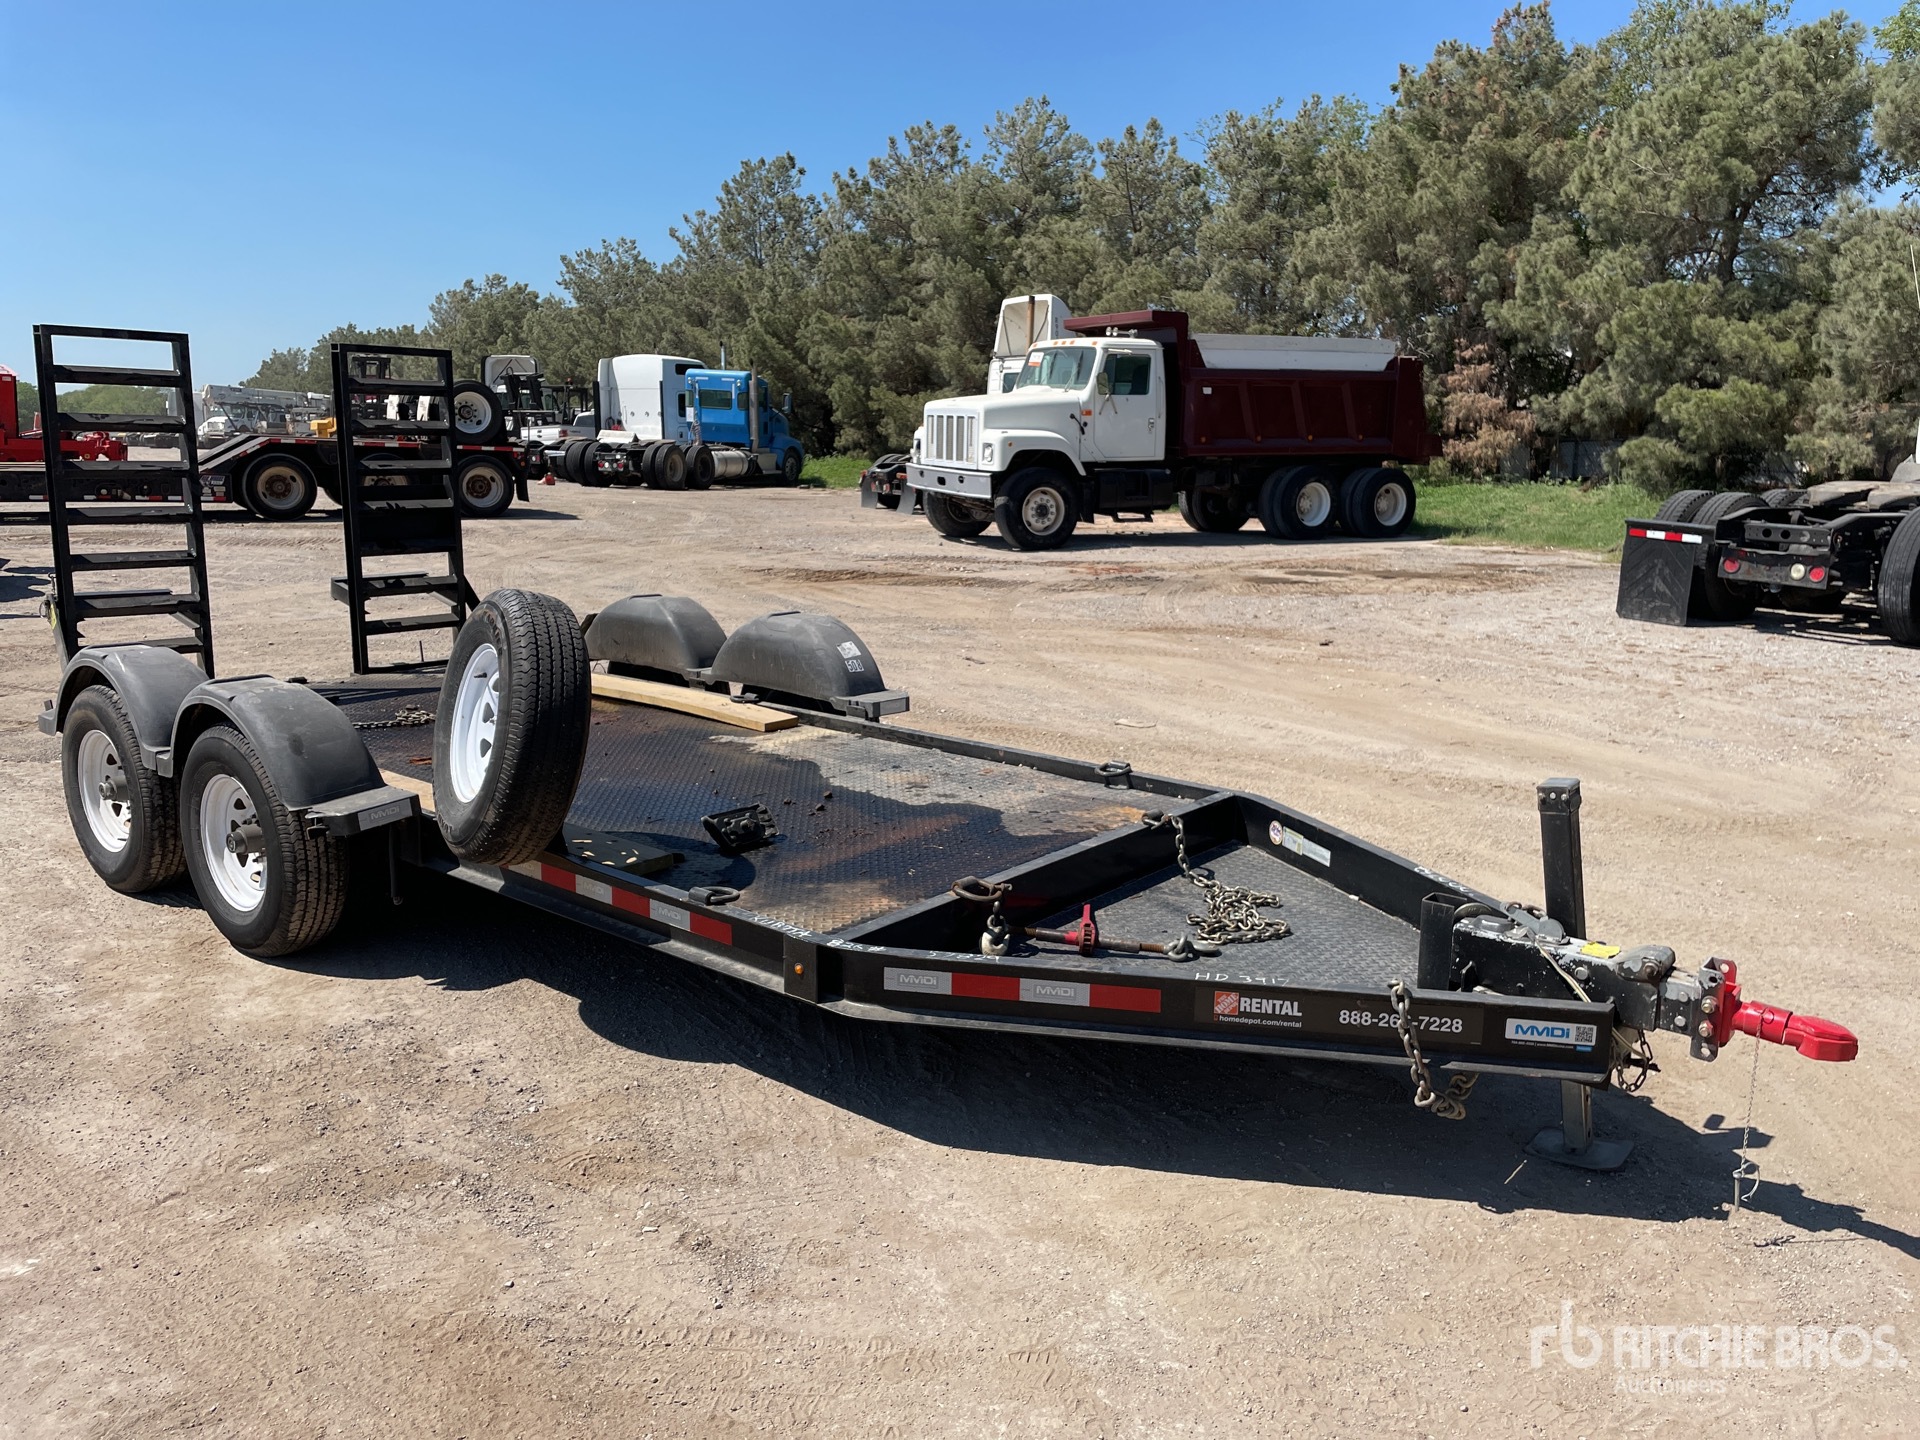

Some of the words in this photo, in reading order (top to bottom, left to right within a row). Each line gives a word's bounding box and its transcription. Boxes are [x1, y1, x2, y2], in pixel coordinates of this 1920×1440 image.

[1214, 993, 1239, 1013] HOME
[1240, 997, 1302, 1016] RENTAL
[1219, 1015, 1302, 1028] homedepot.com/rental
[1338, 1009, 1463, 1033] 888-26-7228
